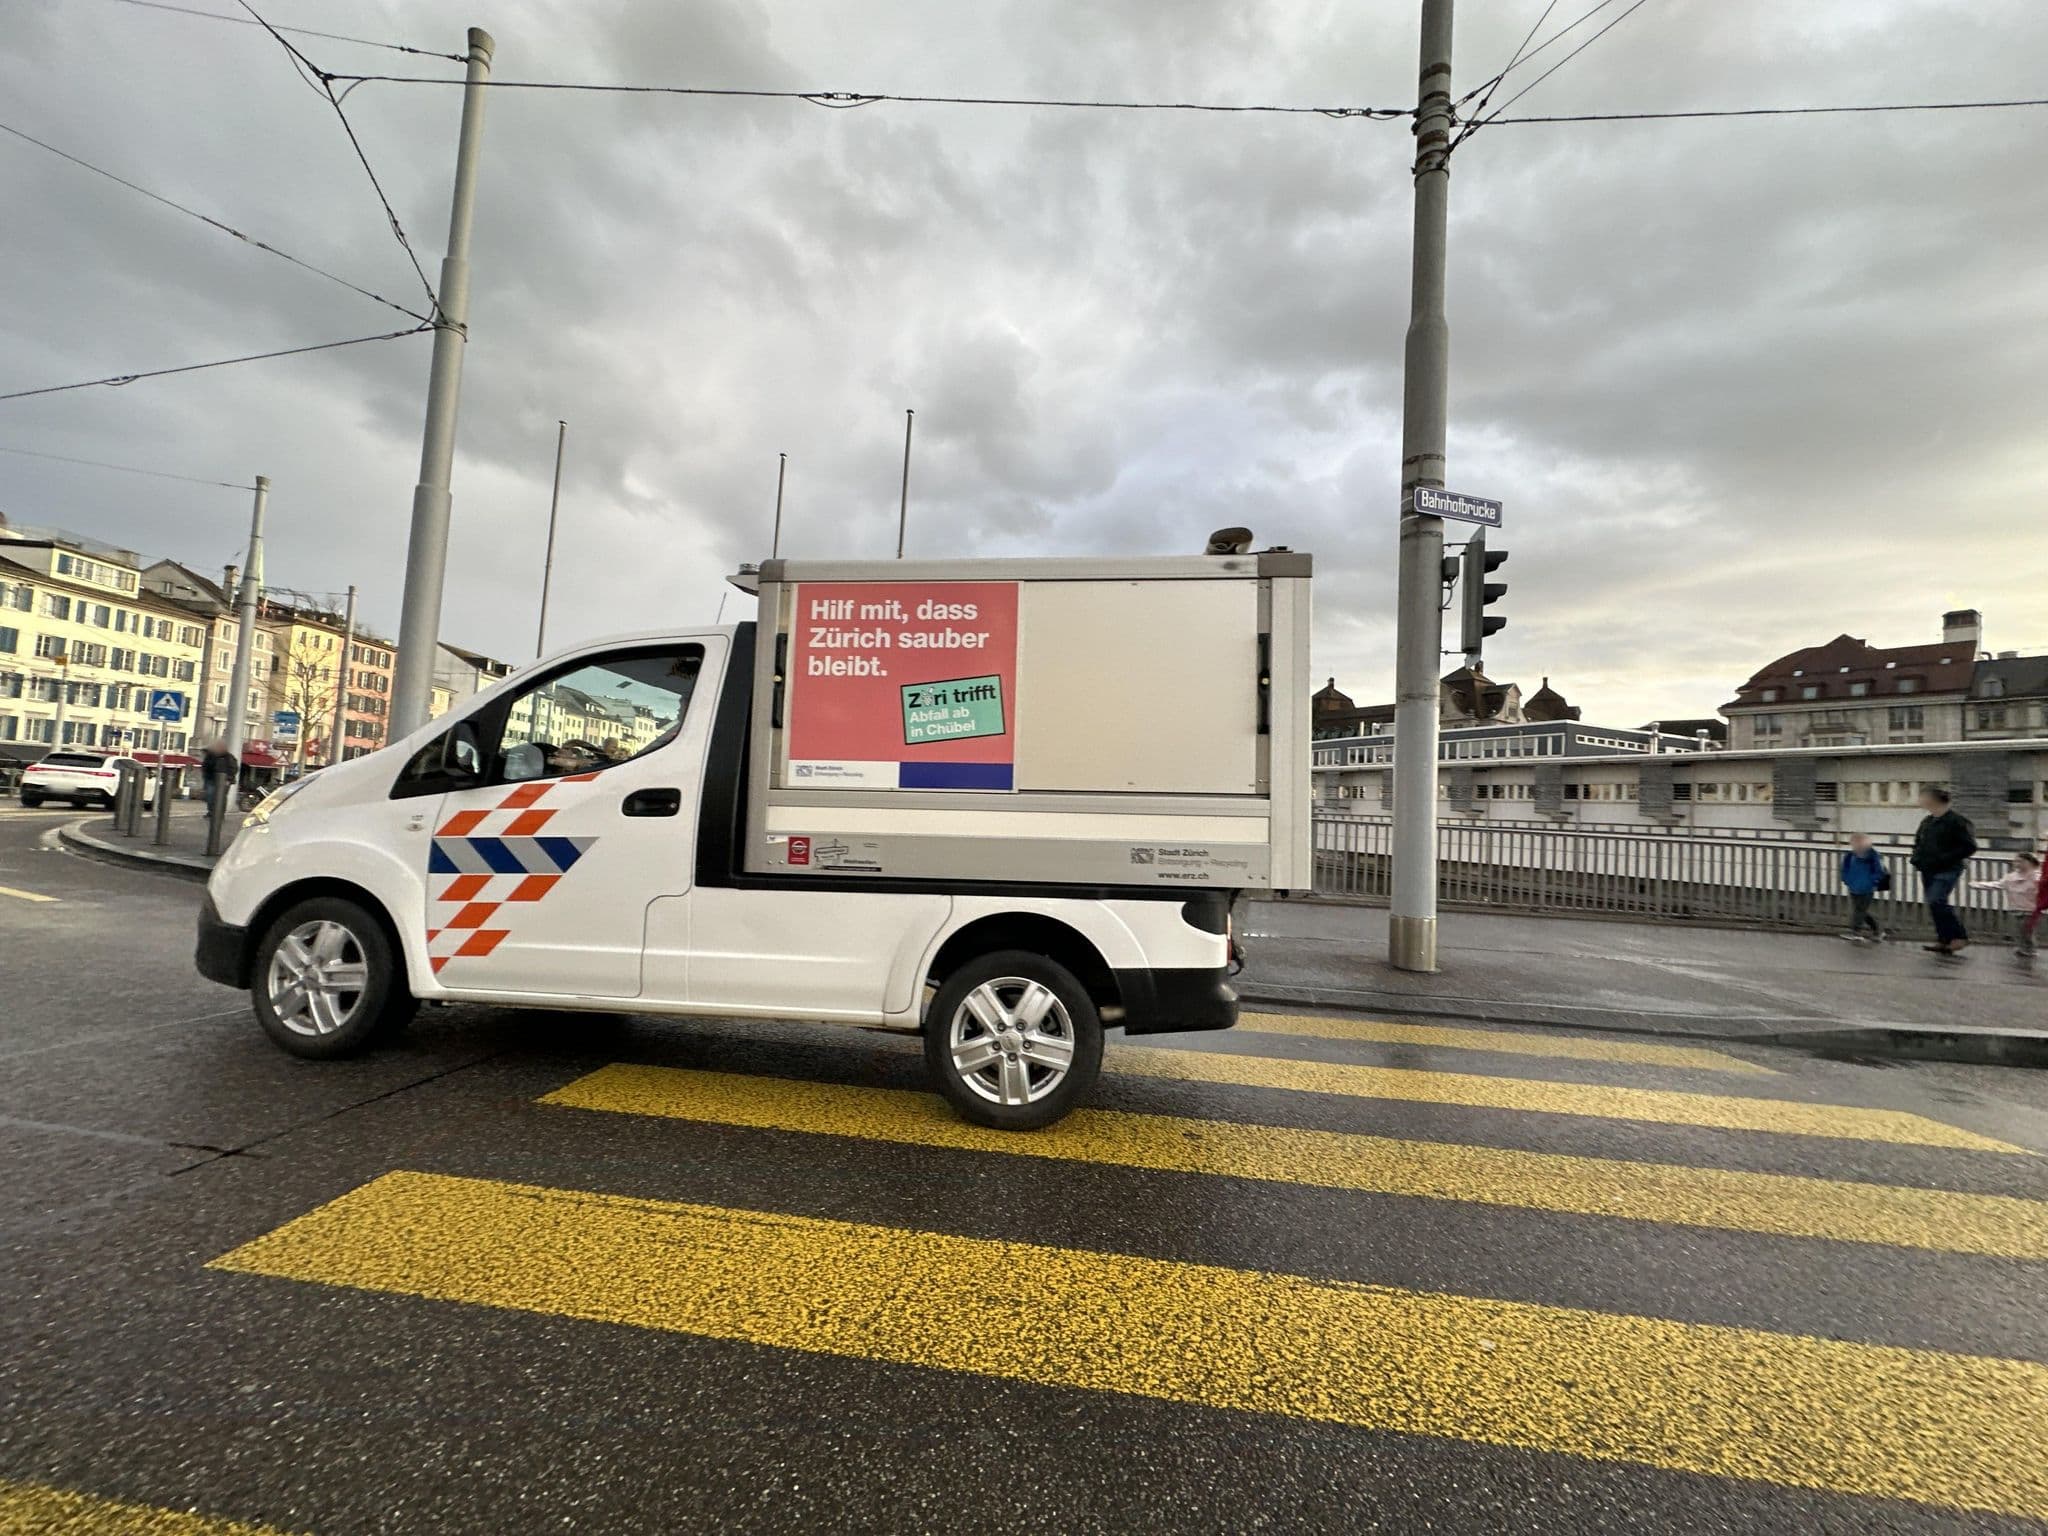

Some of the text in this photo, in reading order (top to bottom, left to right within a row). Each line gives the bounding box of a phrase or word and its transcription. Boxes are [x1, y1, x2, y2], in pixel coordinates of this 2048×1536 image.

[1421, 490, 1496, 519] Bahnhofbrücke
[811, 599, 978, 624] Hilf mit, dass
[808, 627, 990, 649] Zürich sauber
[807, 655, 888, 676] bleibt.
[952, 685, 997, 703] trifft
[910, 706, 970, 723] Abfall ab
[911, 720, 976, 737] in Chübel
